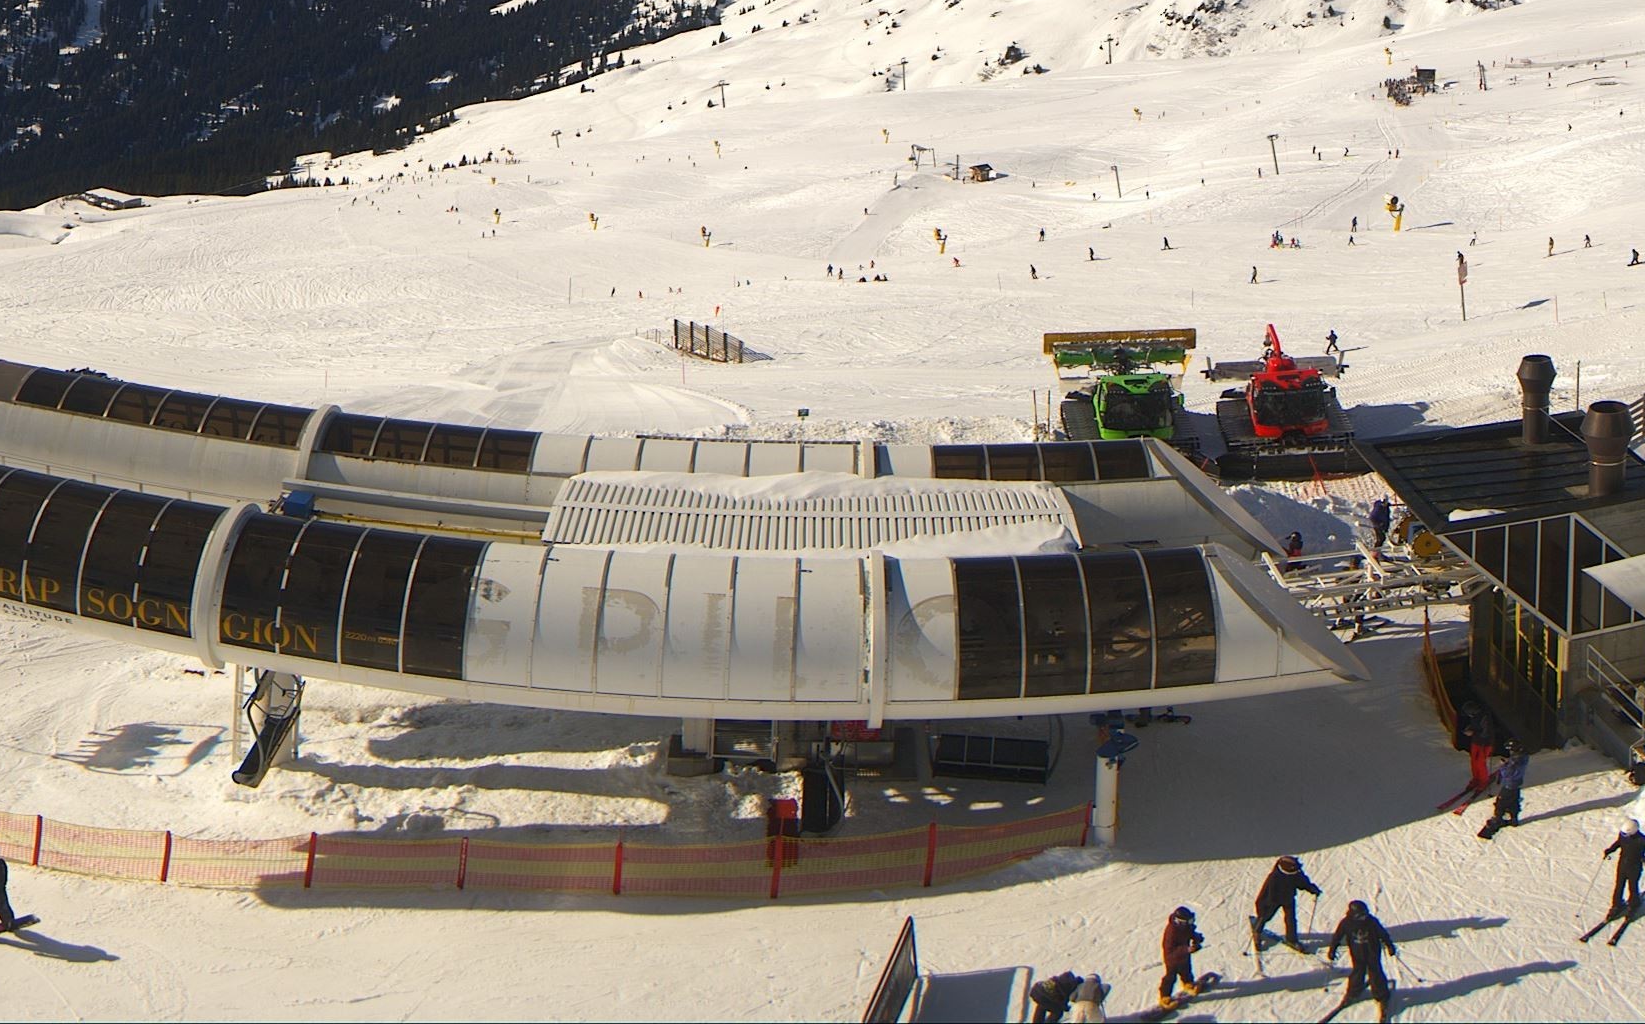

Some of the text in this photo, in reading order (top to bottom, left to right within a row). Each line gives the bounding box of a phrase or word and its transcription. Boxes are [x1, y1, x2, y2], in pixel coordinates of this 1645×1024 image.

[3, 603, 74, 625] ALTITUDE
[87, 587, 189, 631] SOGN
[223, 612, 321, 653] GION
